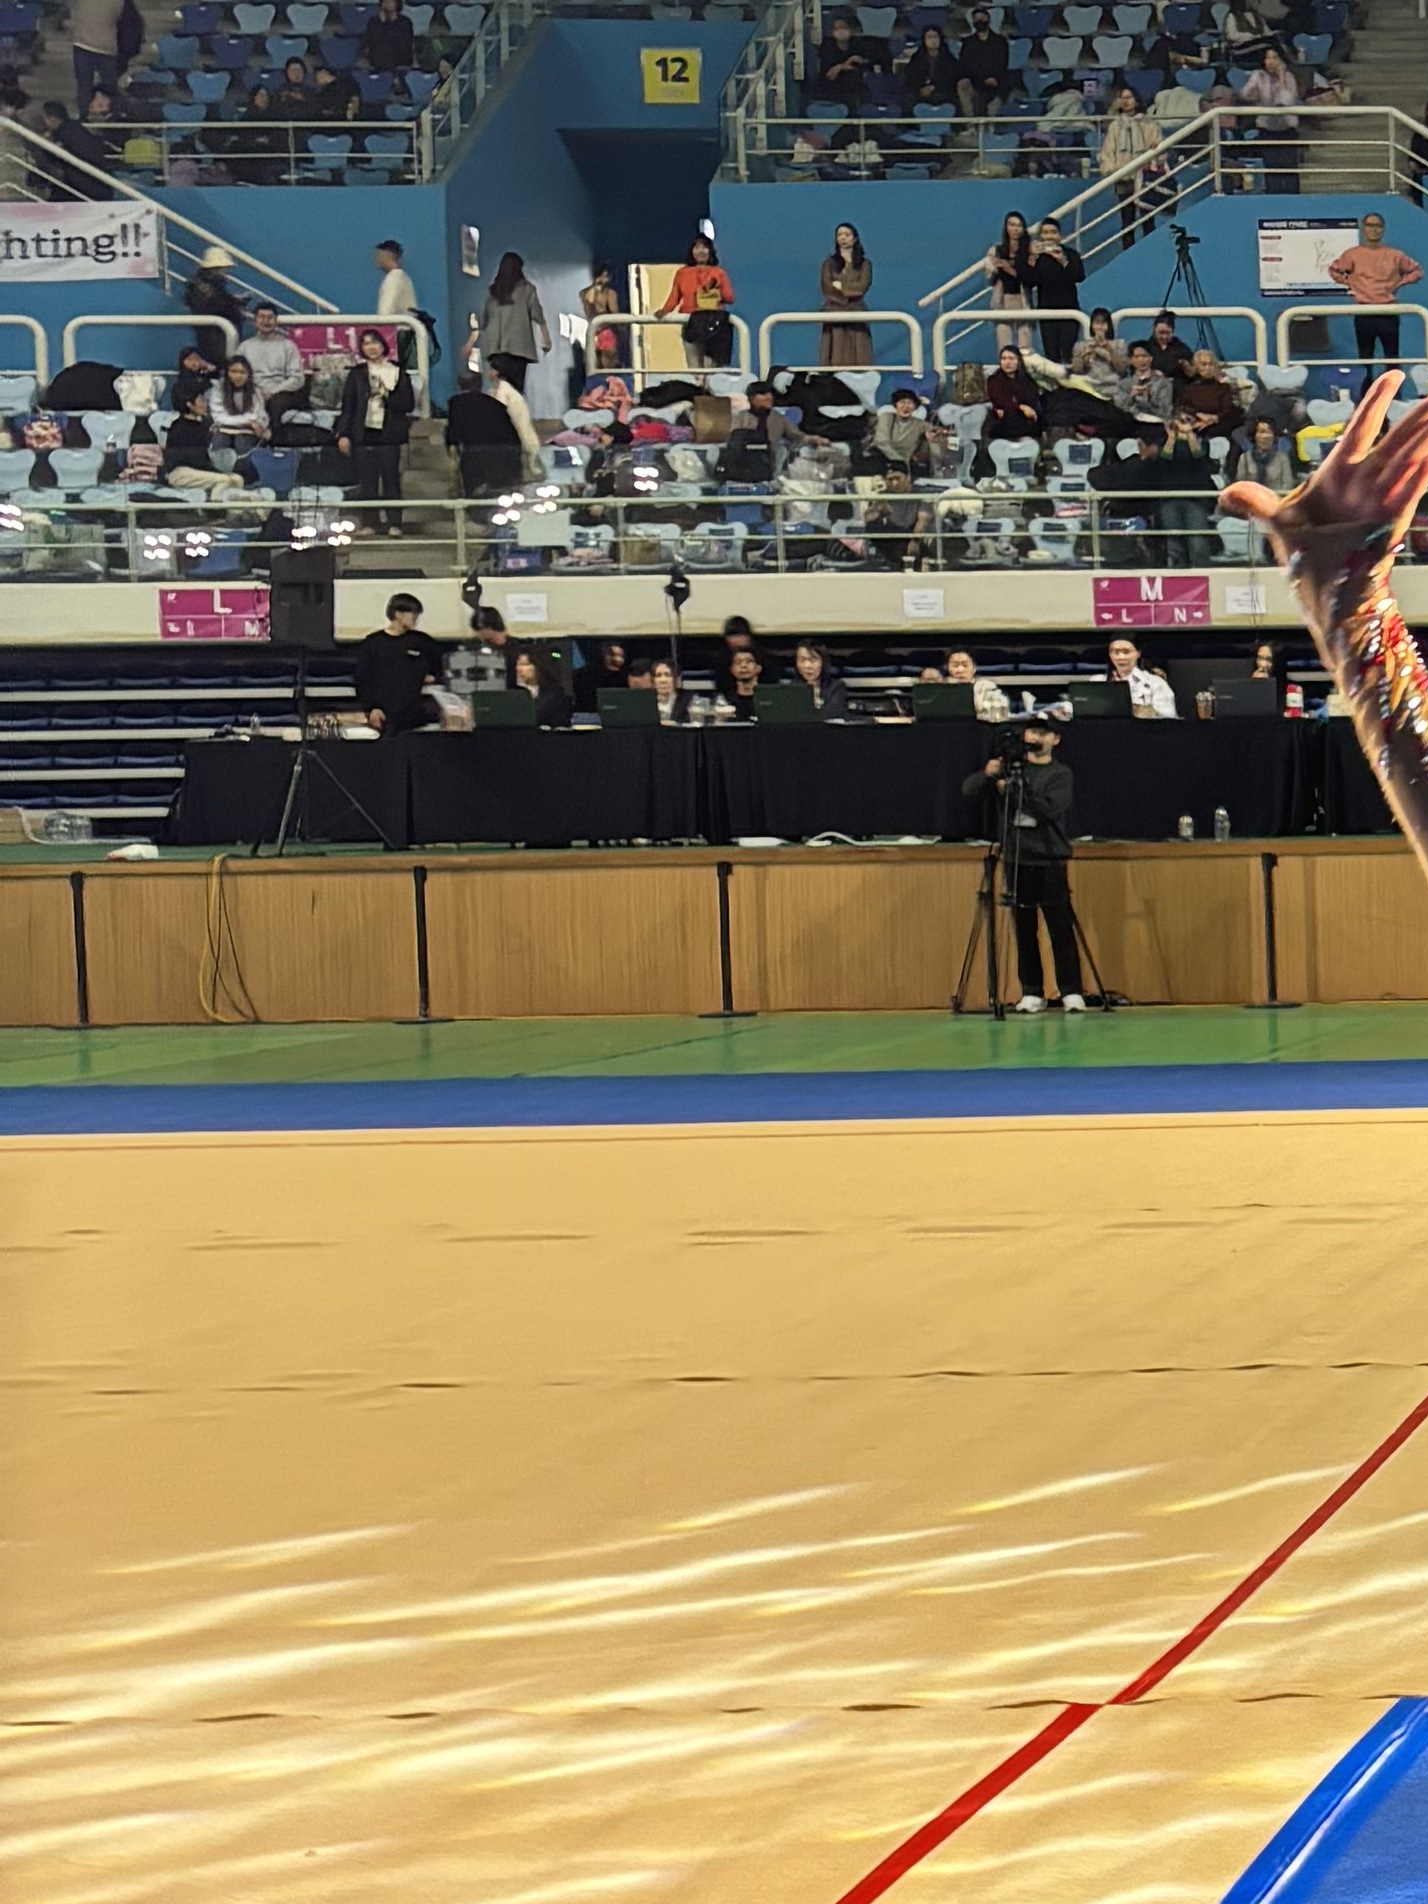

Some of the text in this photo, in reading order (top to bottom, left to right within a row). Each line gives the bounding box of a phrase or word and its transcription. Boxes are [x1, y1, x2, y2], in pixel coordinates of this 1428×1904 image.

[656, 57, 690, 83] 12
[326, 327, 356, 353] L1
[213, 588, 233, 614] L
[1141, 576, 1163, 601] M
[1121, 608, 1133, 623] L
[1173, 608, 1187, 623] N
